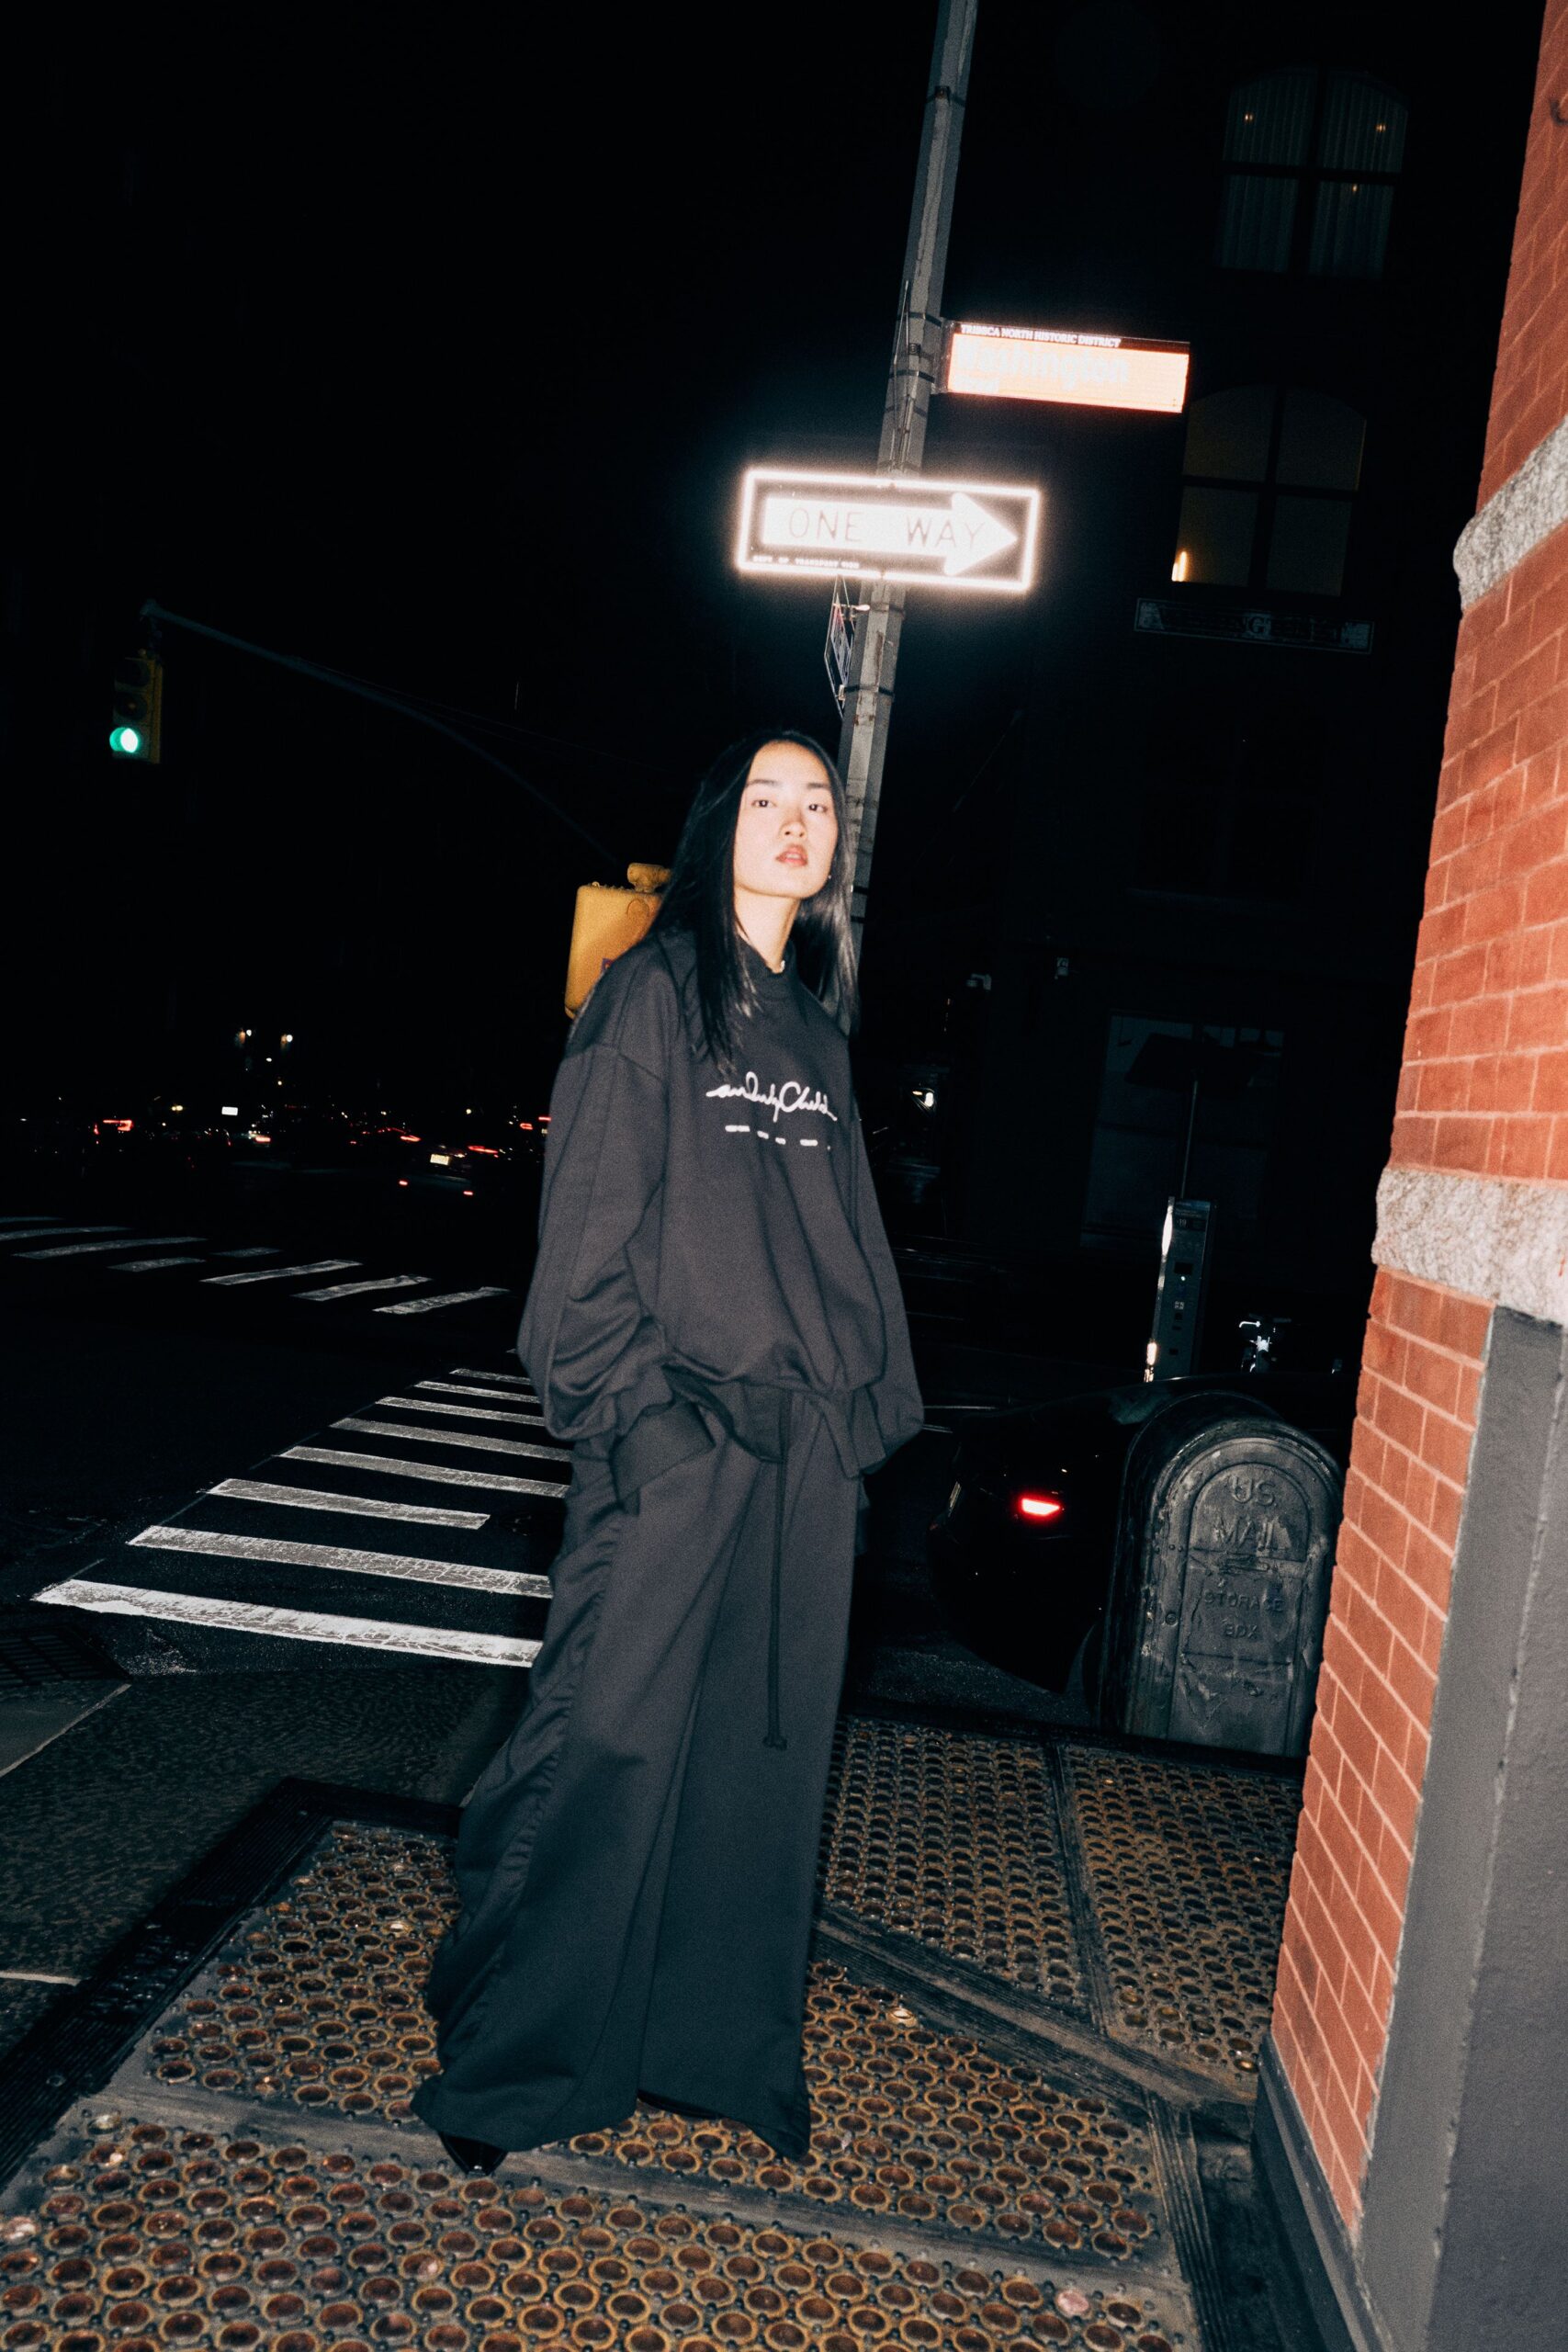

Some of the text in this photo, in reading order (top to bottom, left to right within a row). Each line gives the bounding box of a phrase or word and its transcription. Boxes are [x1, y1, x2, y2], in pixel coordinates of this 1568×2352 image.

[960, 323, 1122, 348] TRIBECA NORTH HISTORIC DISTRICT
[957, 338, 1129, 392] Washington
[789, 506, 985, 549] ONE WAY
[1213, 1515, 1282, 1551] MAIL
[1223, 1622, 1258, 1639] BOX
